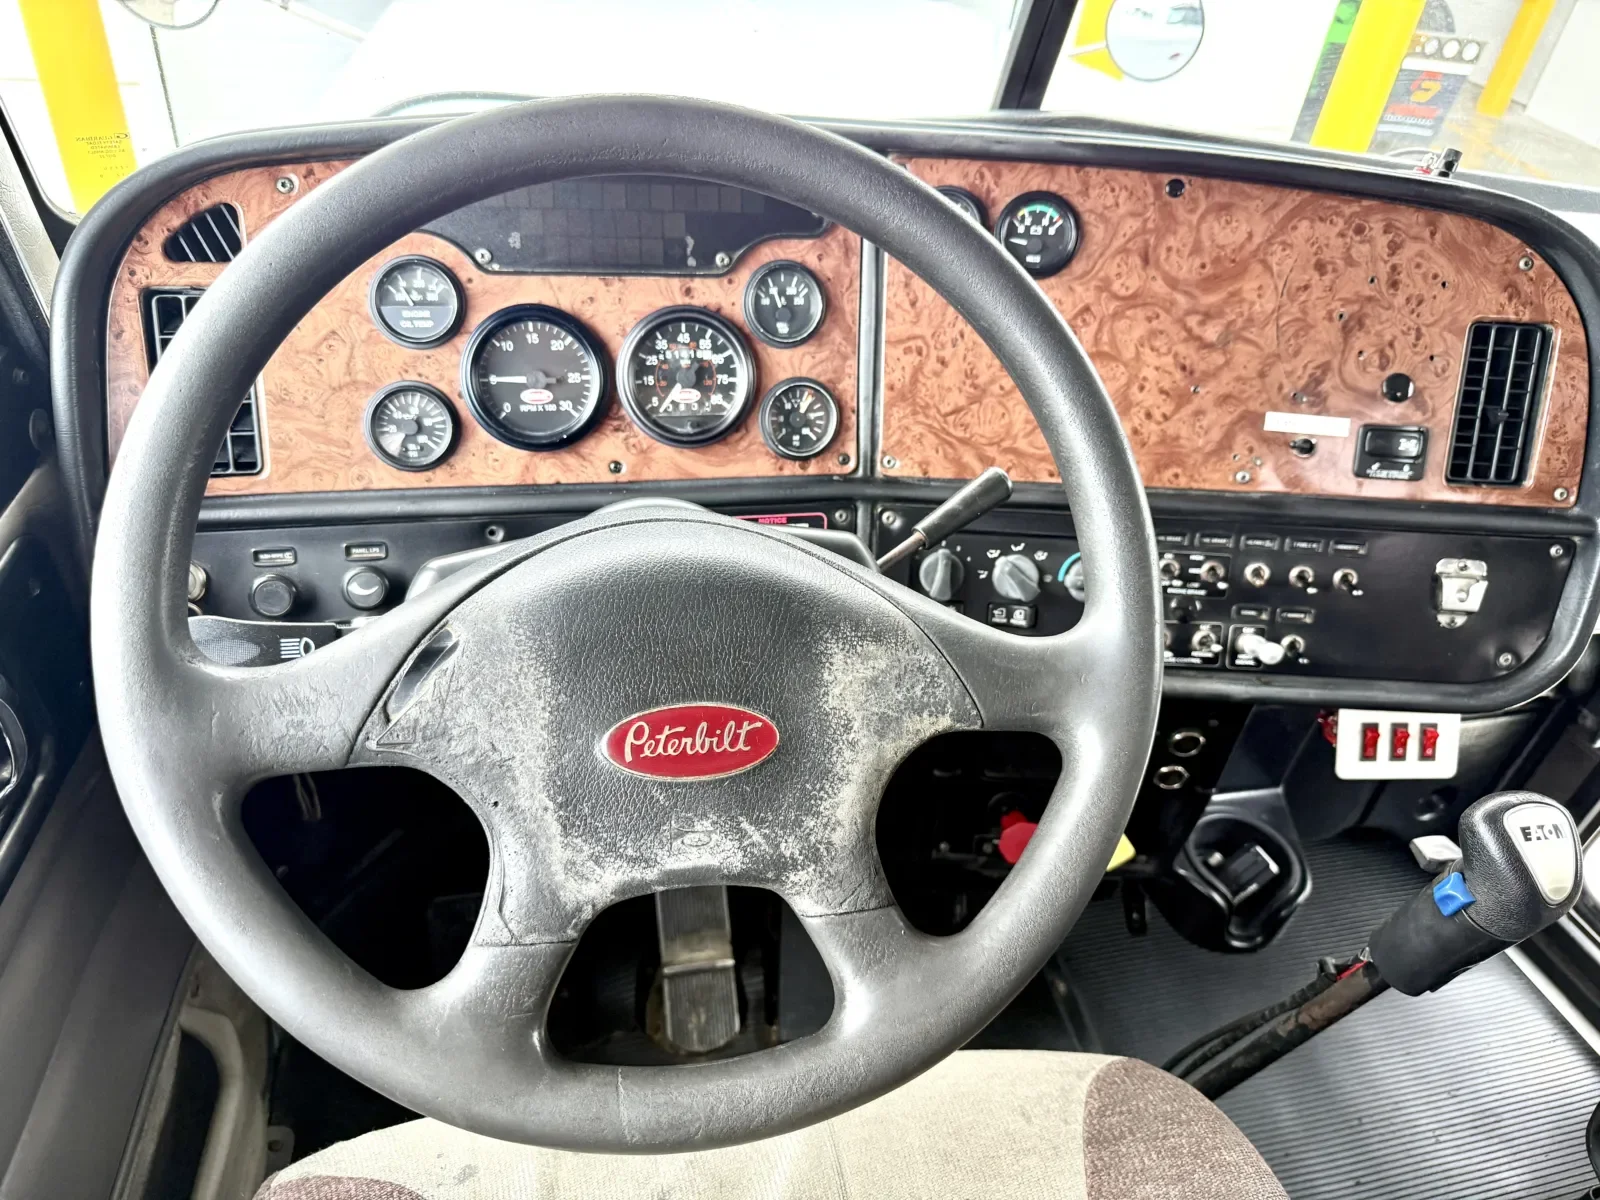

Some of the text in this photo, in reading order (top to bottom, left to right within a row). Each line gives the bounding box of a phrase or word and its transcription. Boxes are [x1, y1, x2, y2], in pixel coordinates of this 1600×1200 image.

[525, 333, 540, 345] 15
[677, 333, 690, 344] 45
[699, 339, 712, 349] 55
[500, 340, 514, 352] 10
[550, 339, 564, 351] 20
[655, 340, 668, 350] 35
[645, 355, 658, 366] 25
[711, 354, 725, 364] 65
[567, 372, 581, 383] 25
[643, 375, 655, 386] 15
[716, 374, 729, 385] 75
[559, 400, 573, 411] 30
[651, 396, 659, 407] 5
[503, 402, 512, 413] 0
[519, 404, 537, 412] RPM
[537, 404, 544, 412] X
[624, 720, 763, 763] Peterbilt
[1519, 822, 1568, 843] EATON
